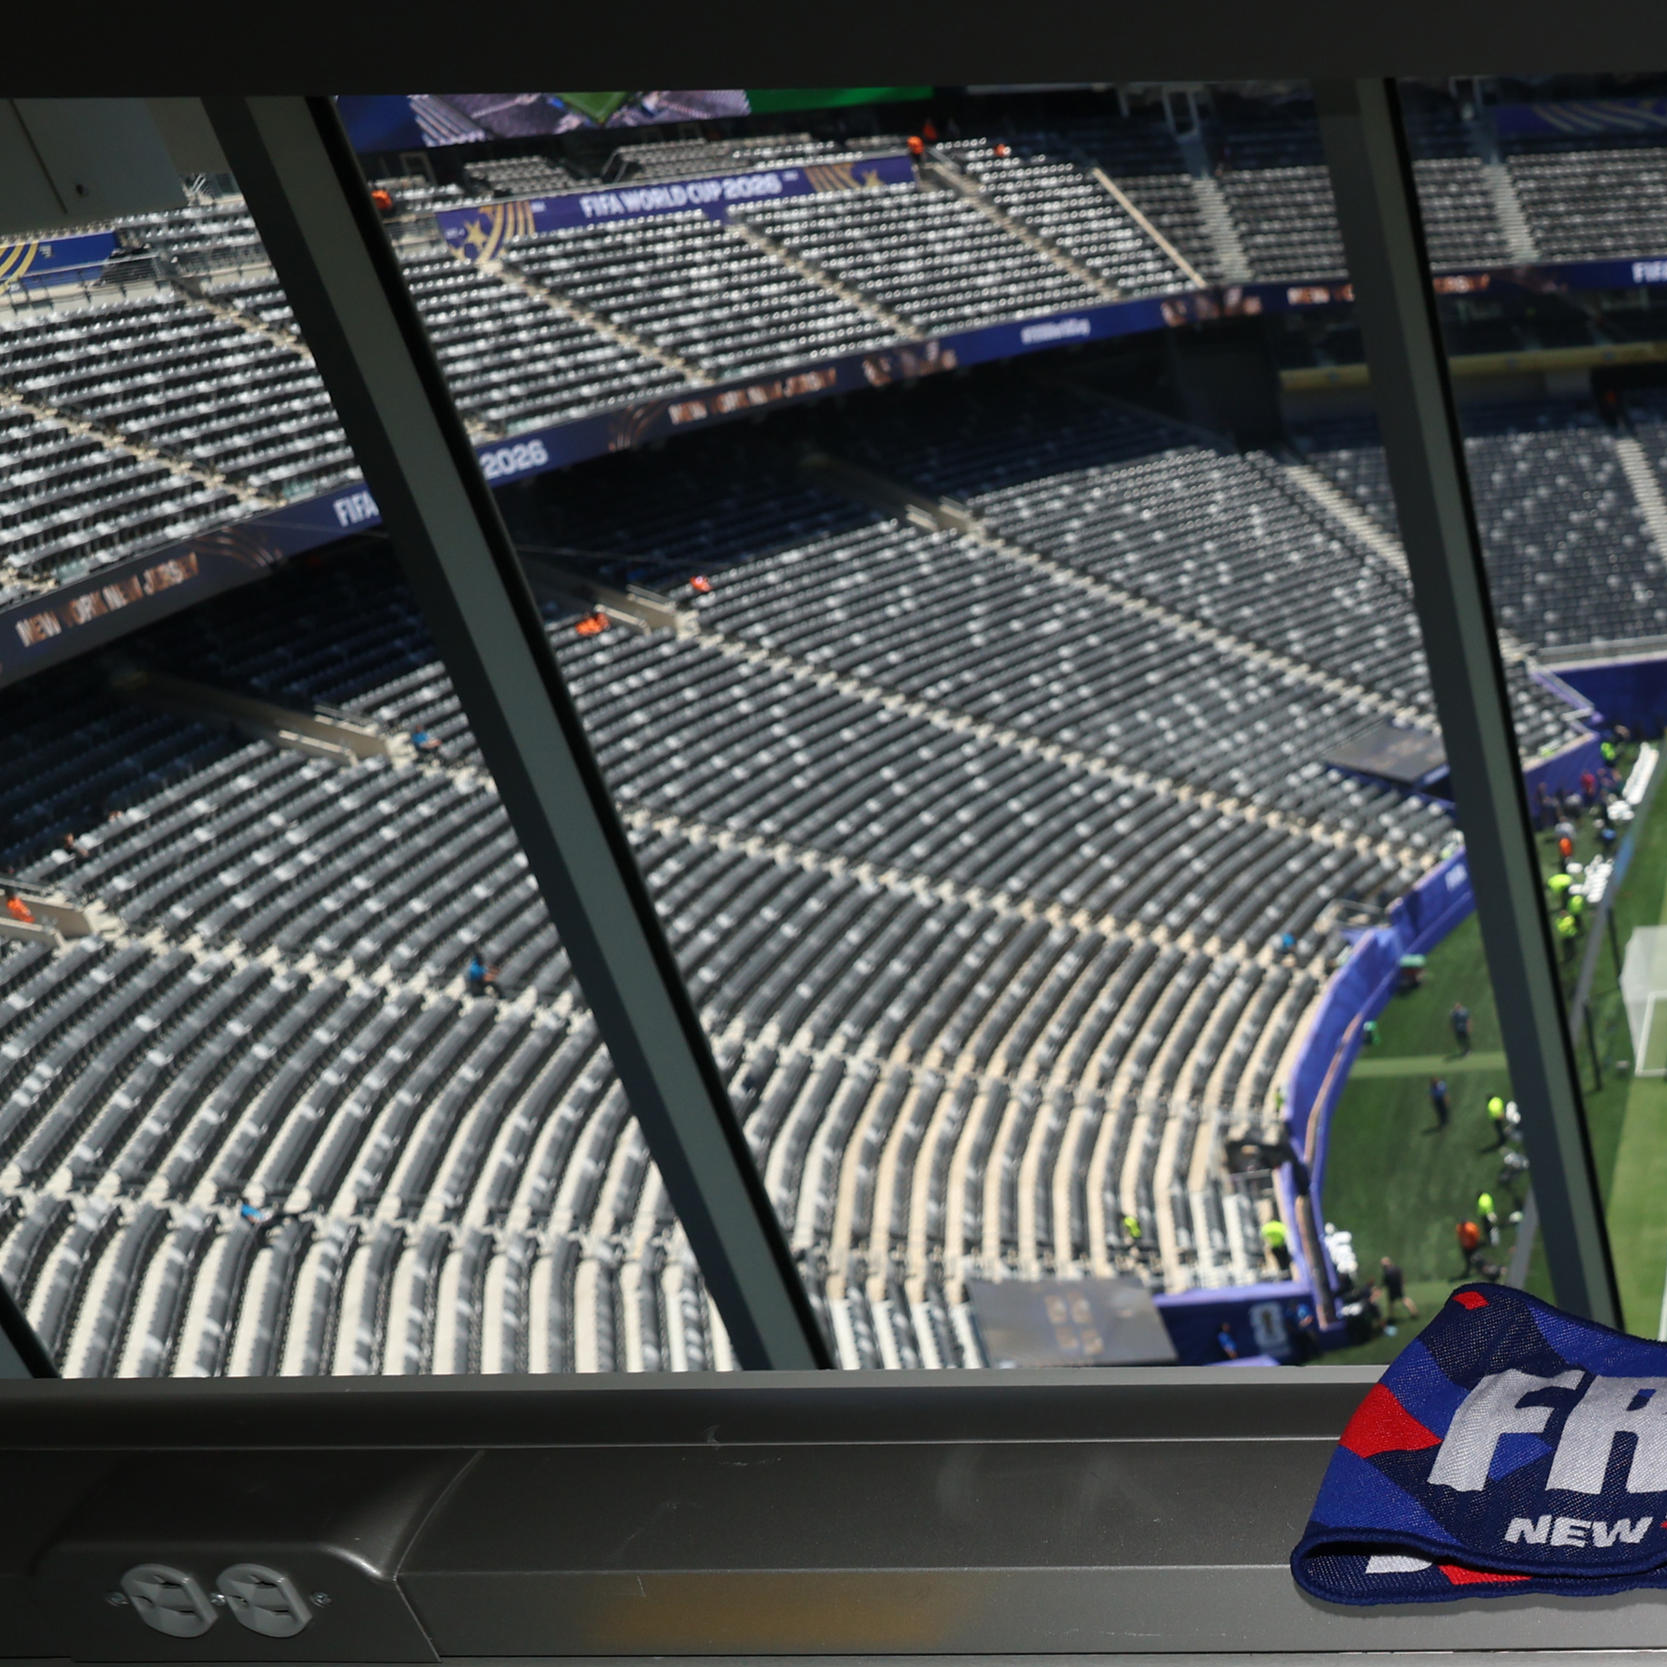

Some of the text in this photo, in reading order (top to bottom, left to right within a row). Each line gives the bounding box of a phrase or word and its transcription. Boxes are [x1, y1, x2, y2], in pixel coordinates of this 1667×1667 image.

[579, 192, 624, 218] FIFA
[622, 184, 688, 213] WORLD
[685, 179, 723, 205] CUP
[722, 173, 782, 199] 2026
[479, 439, 549, 481] 2026
[333, 490, 381, 528] FIFA
[1504, 1514, 1654, 1548] NEW
